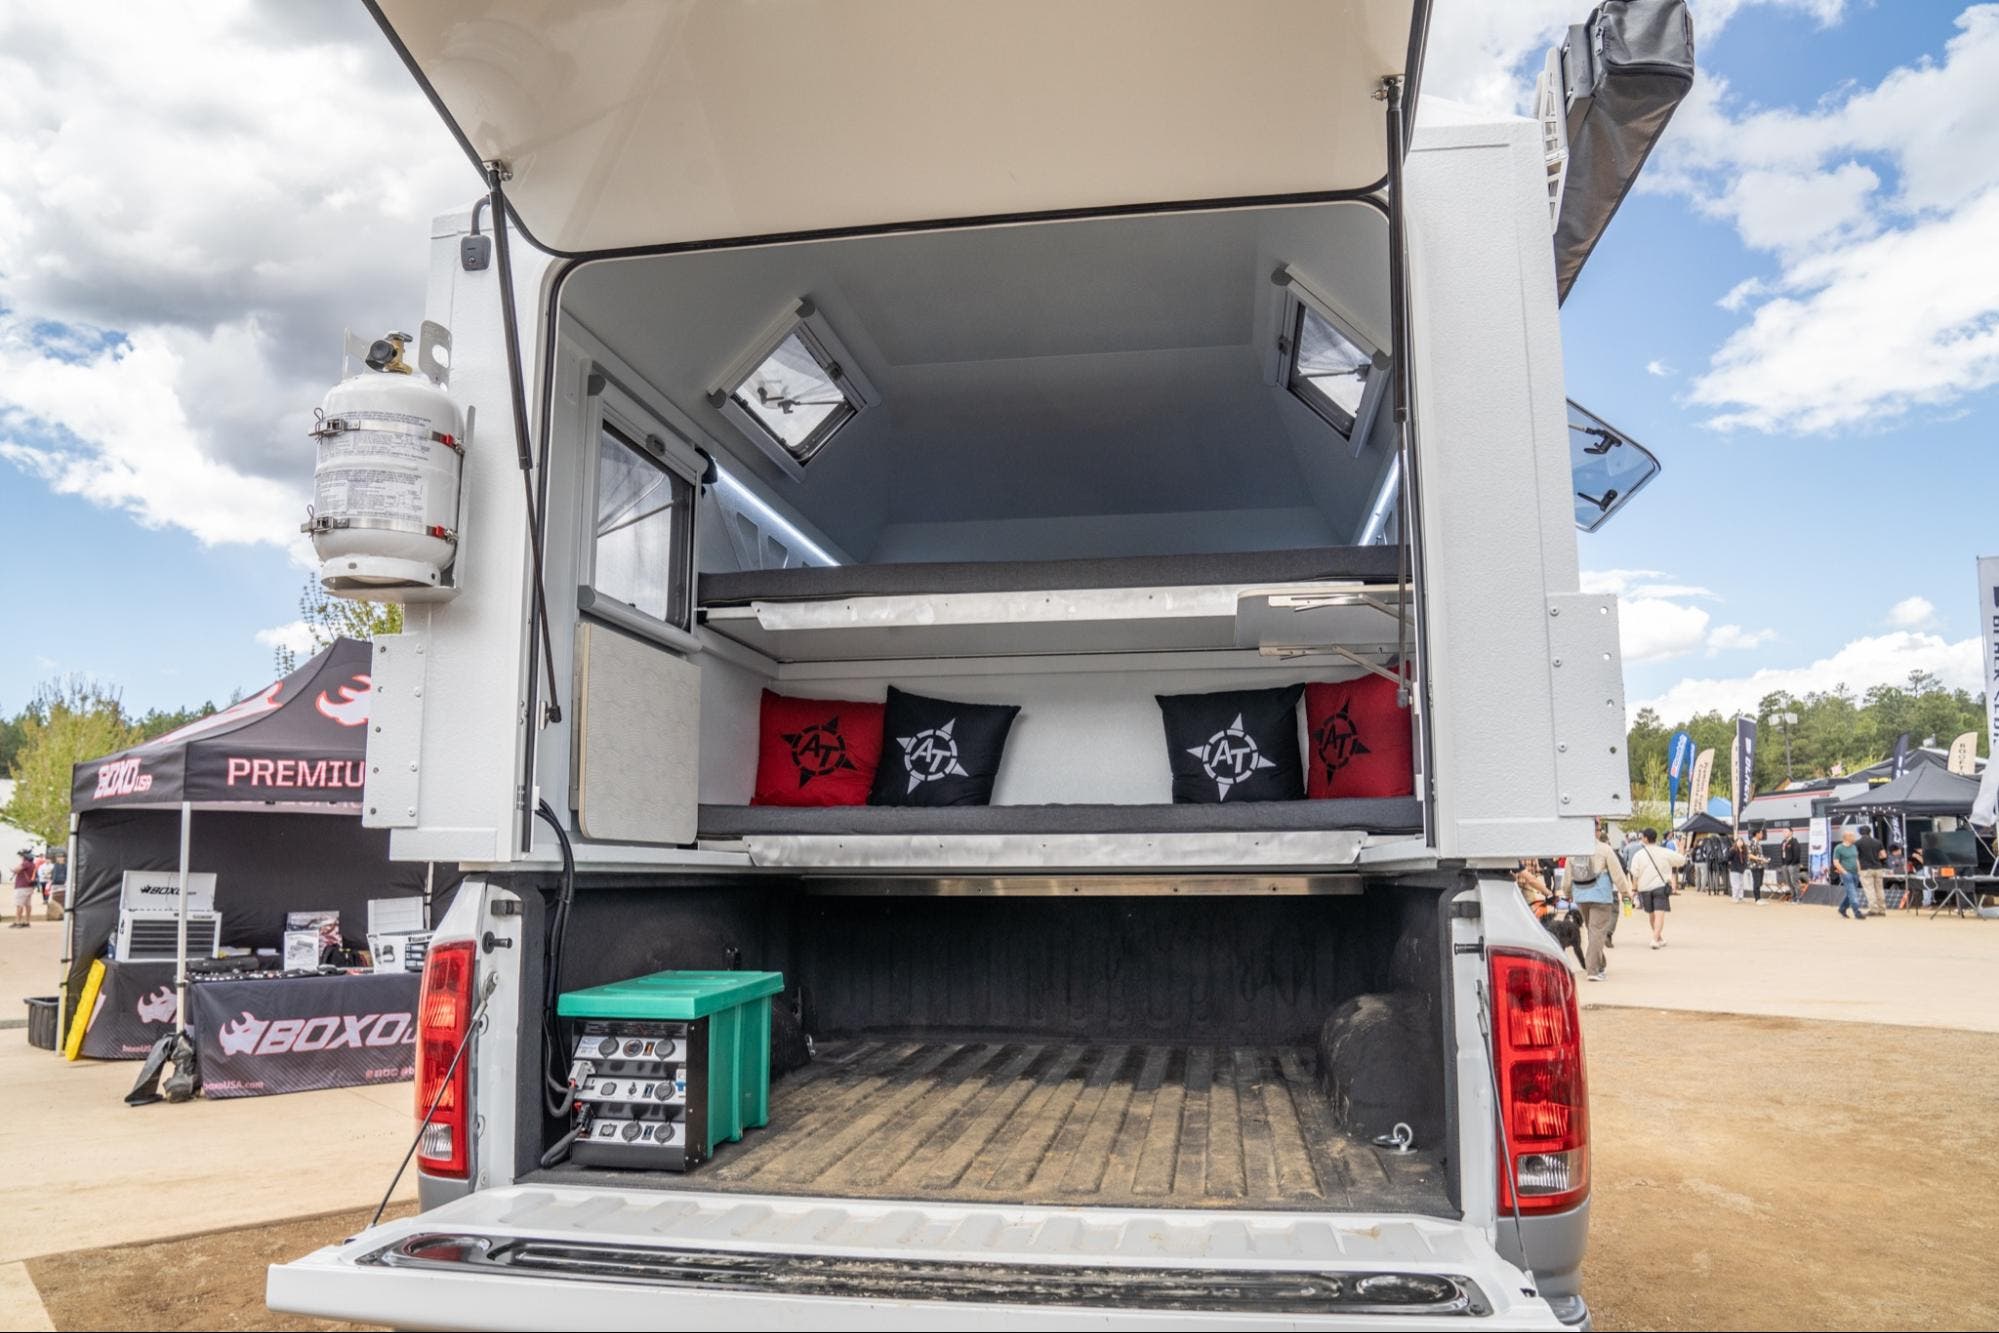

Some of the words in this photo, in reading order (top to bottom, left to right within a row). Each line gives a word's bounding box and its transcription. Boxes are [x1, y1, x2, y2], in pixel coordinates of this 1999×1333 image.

[800, 735, 840, 768] AT
[911, 738, 952, 773] AT
[1211, 739, 1250, 774] AT
[1323, 725, 1354, 759] AT
[93, 758, 142, 800] BOXO
[227, 758, 365, 787] PREMIU
[255, 1012, 412, 1055] BOXO
